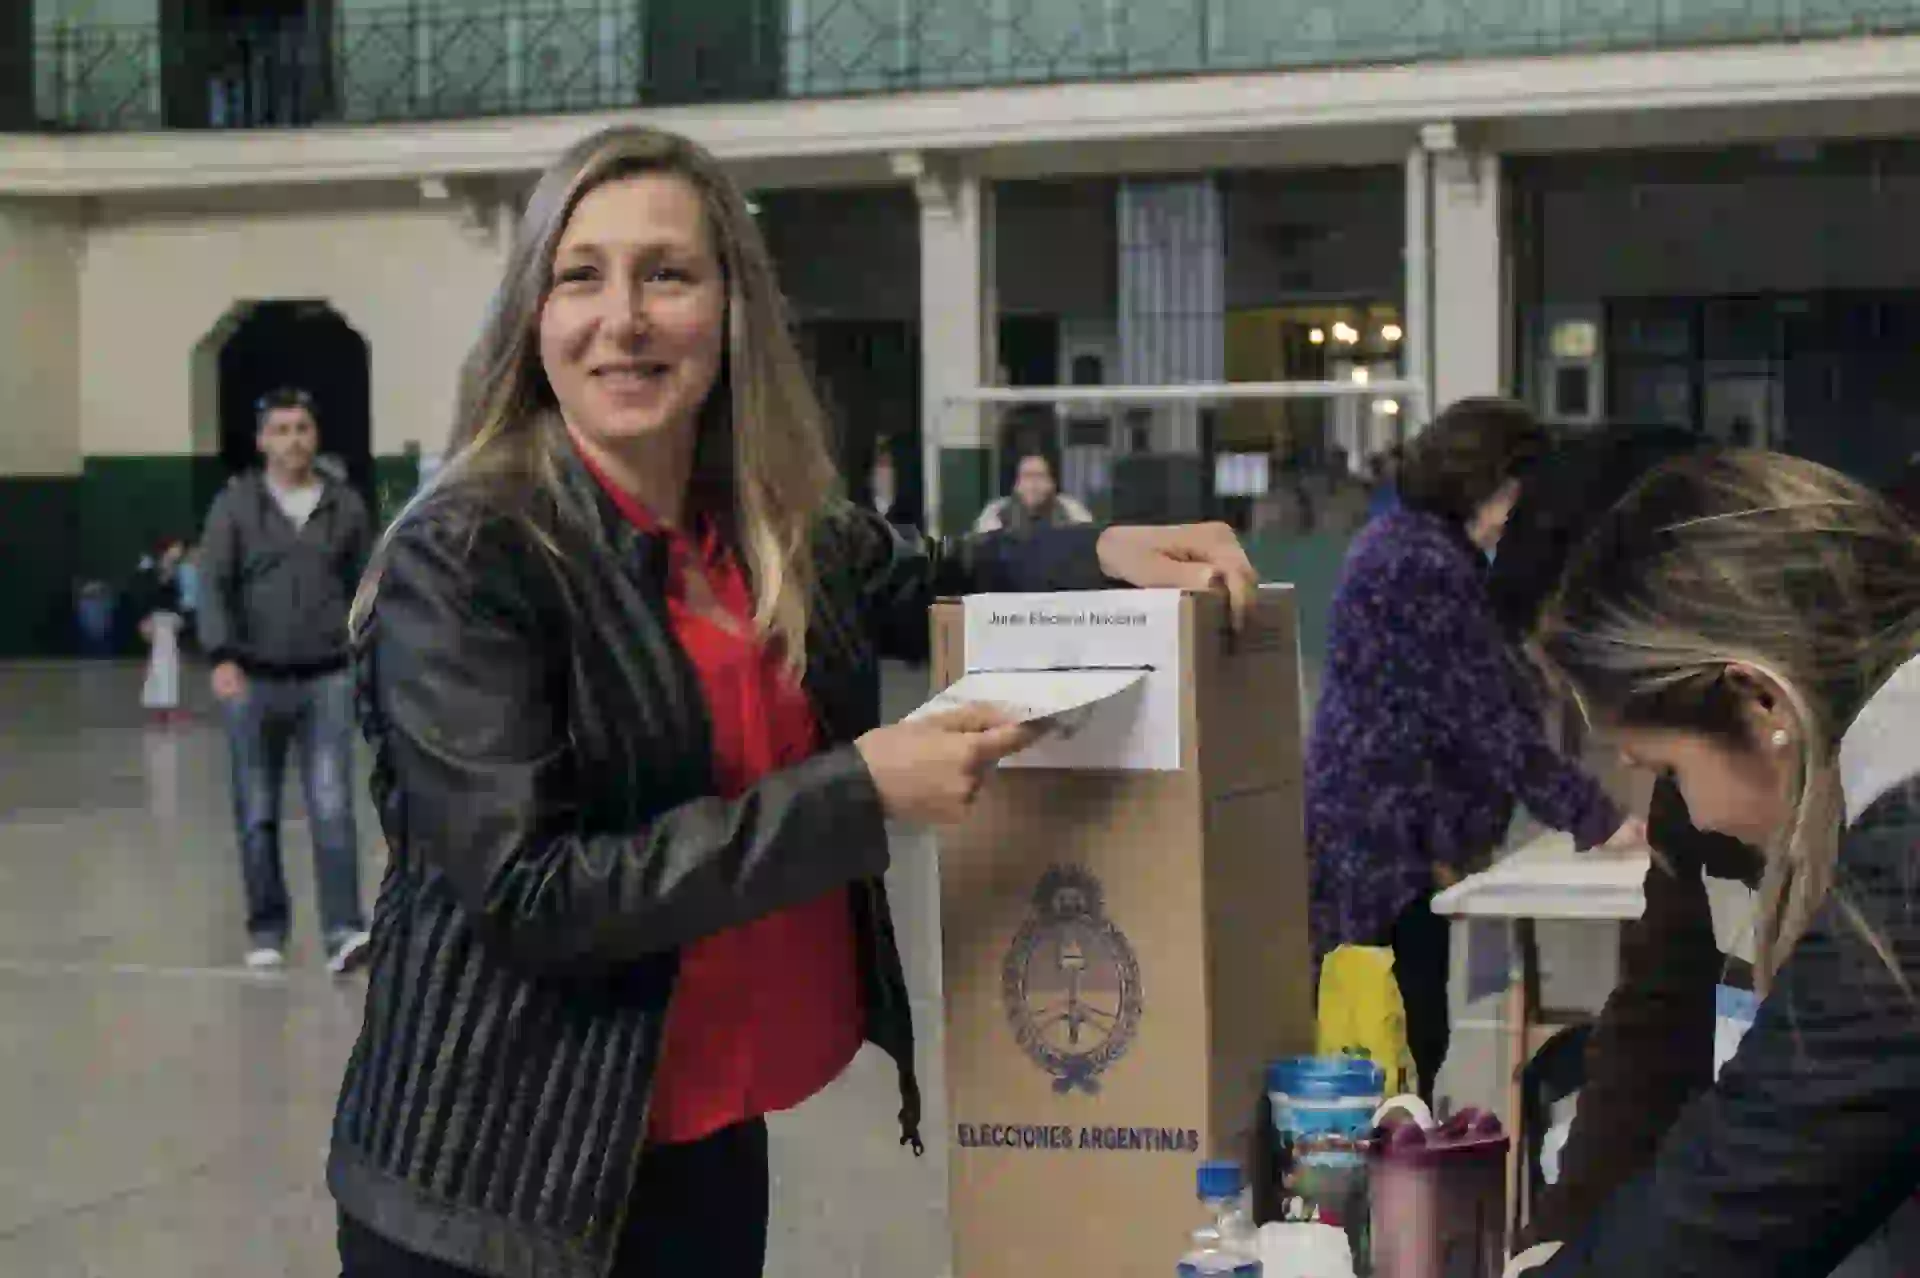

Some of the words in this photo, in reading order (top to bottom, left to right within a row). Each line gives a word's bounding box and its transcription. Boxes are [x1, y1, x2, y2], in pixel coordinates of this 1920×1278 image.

[1030, 610, 1085, 626] Elcal
[957, 1123, 1073, 1148] ELECCIONES
[1078, 1126, 1199, 1152] ARGENTINAS
